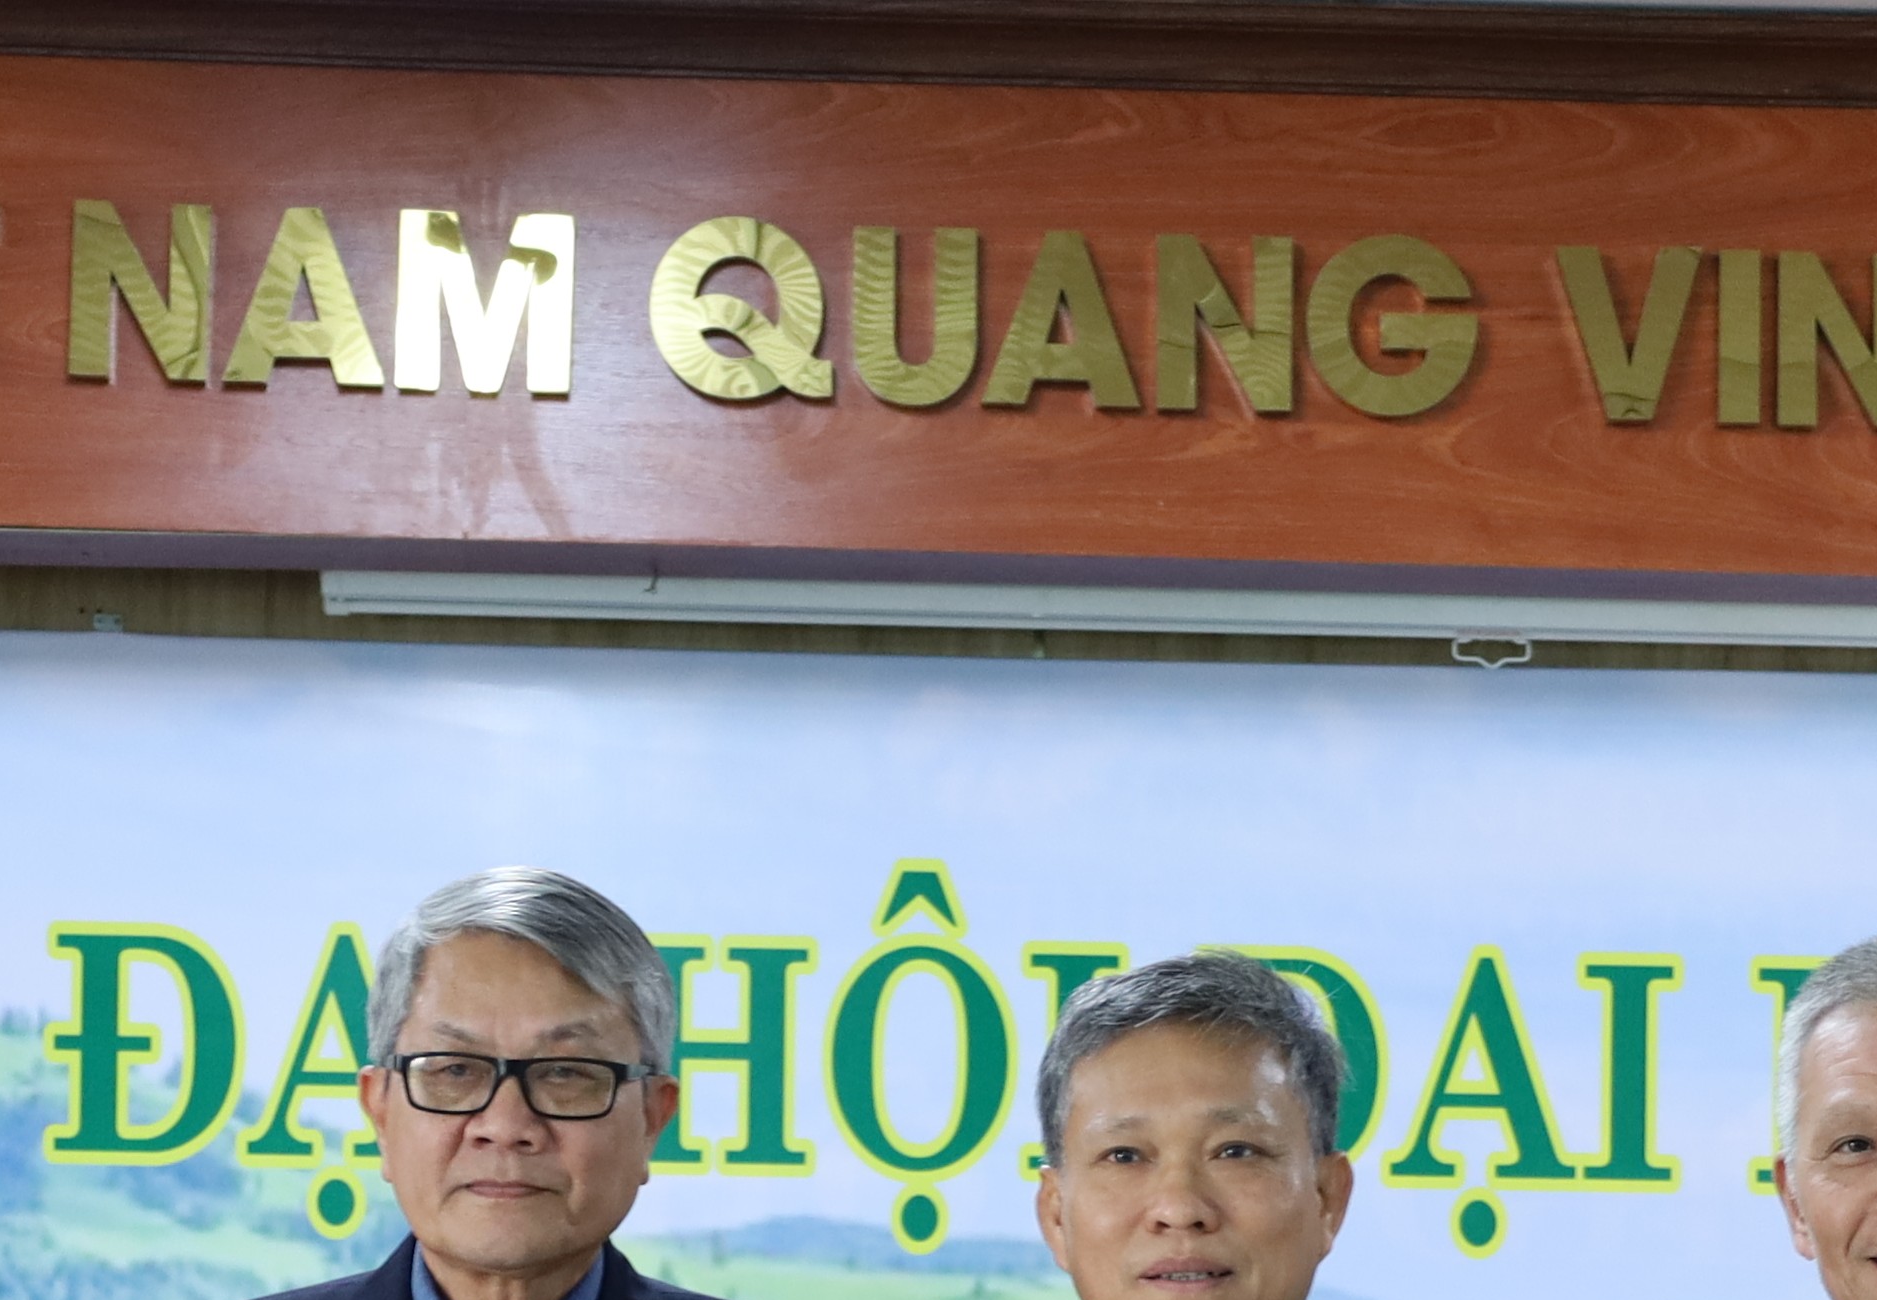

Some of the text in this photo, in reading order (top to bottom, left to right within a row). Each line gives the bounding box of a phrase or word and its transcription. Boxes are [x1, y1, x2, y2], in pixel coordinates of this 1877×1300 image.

[67, 196, 577, 400] NAM
[648, 214, 1480, 420] QUANG
[44, 922, 390, 1240] ĐẠ
